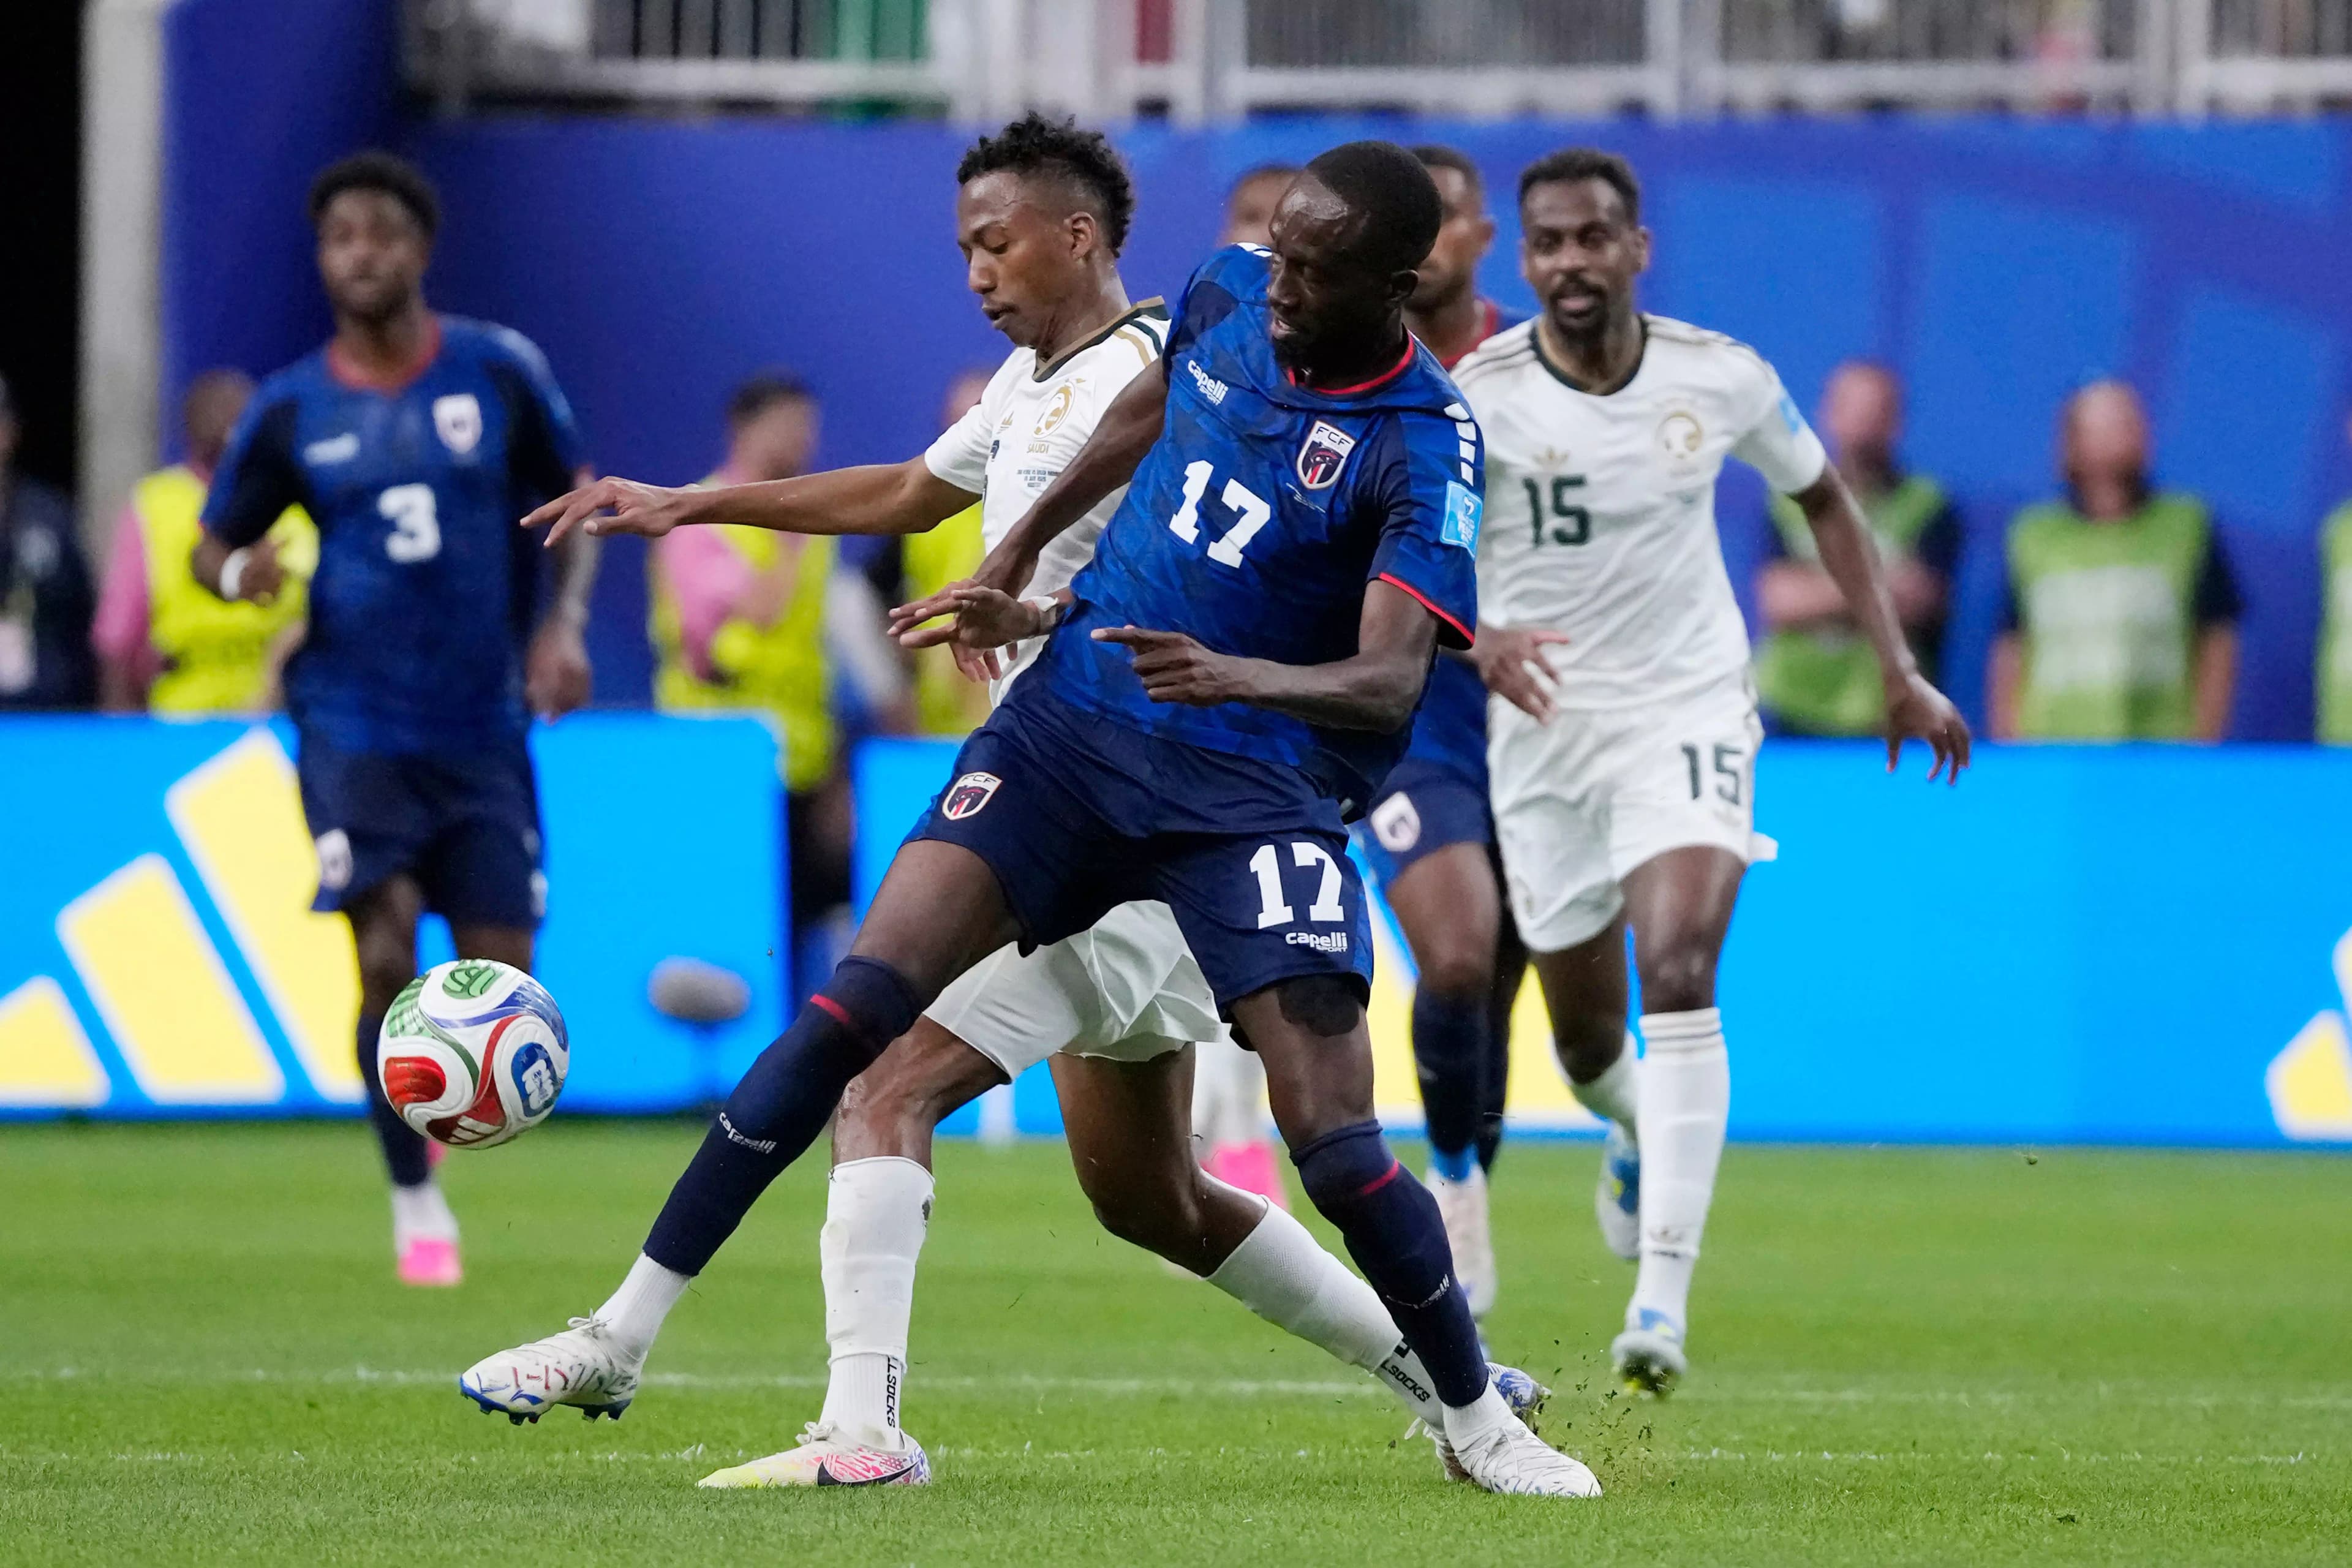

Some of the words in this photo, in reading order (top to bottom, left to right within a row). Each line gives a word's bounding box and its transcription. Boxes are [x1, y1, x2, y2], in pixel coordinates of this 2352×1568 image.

[1188, 360, 1229, 401] capelli
[1316, 426, 1350, 445] FCF
[377, 483, 442, 564] 3
[1169, 460, 1270, 568] 17
[1523, 474, 1593, 548] 15
[962, 774, 997, 783] FCF
[1681, 744, 1744, 805] 15
[1250, 842, 1344, 929] 17
[1286, 932, 1348, 948] capelli
